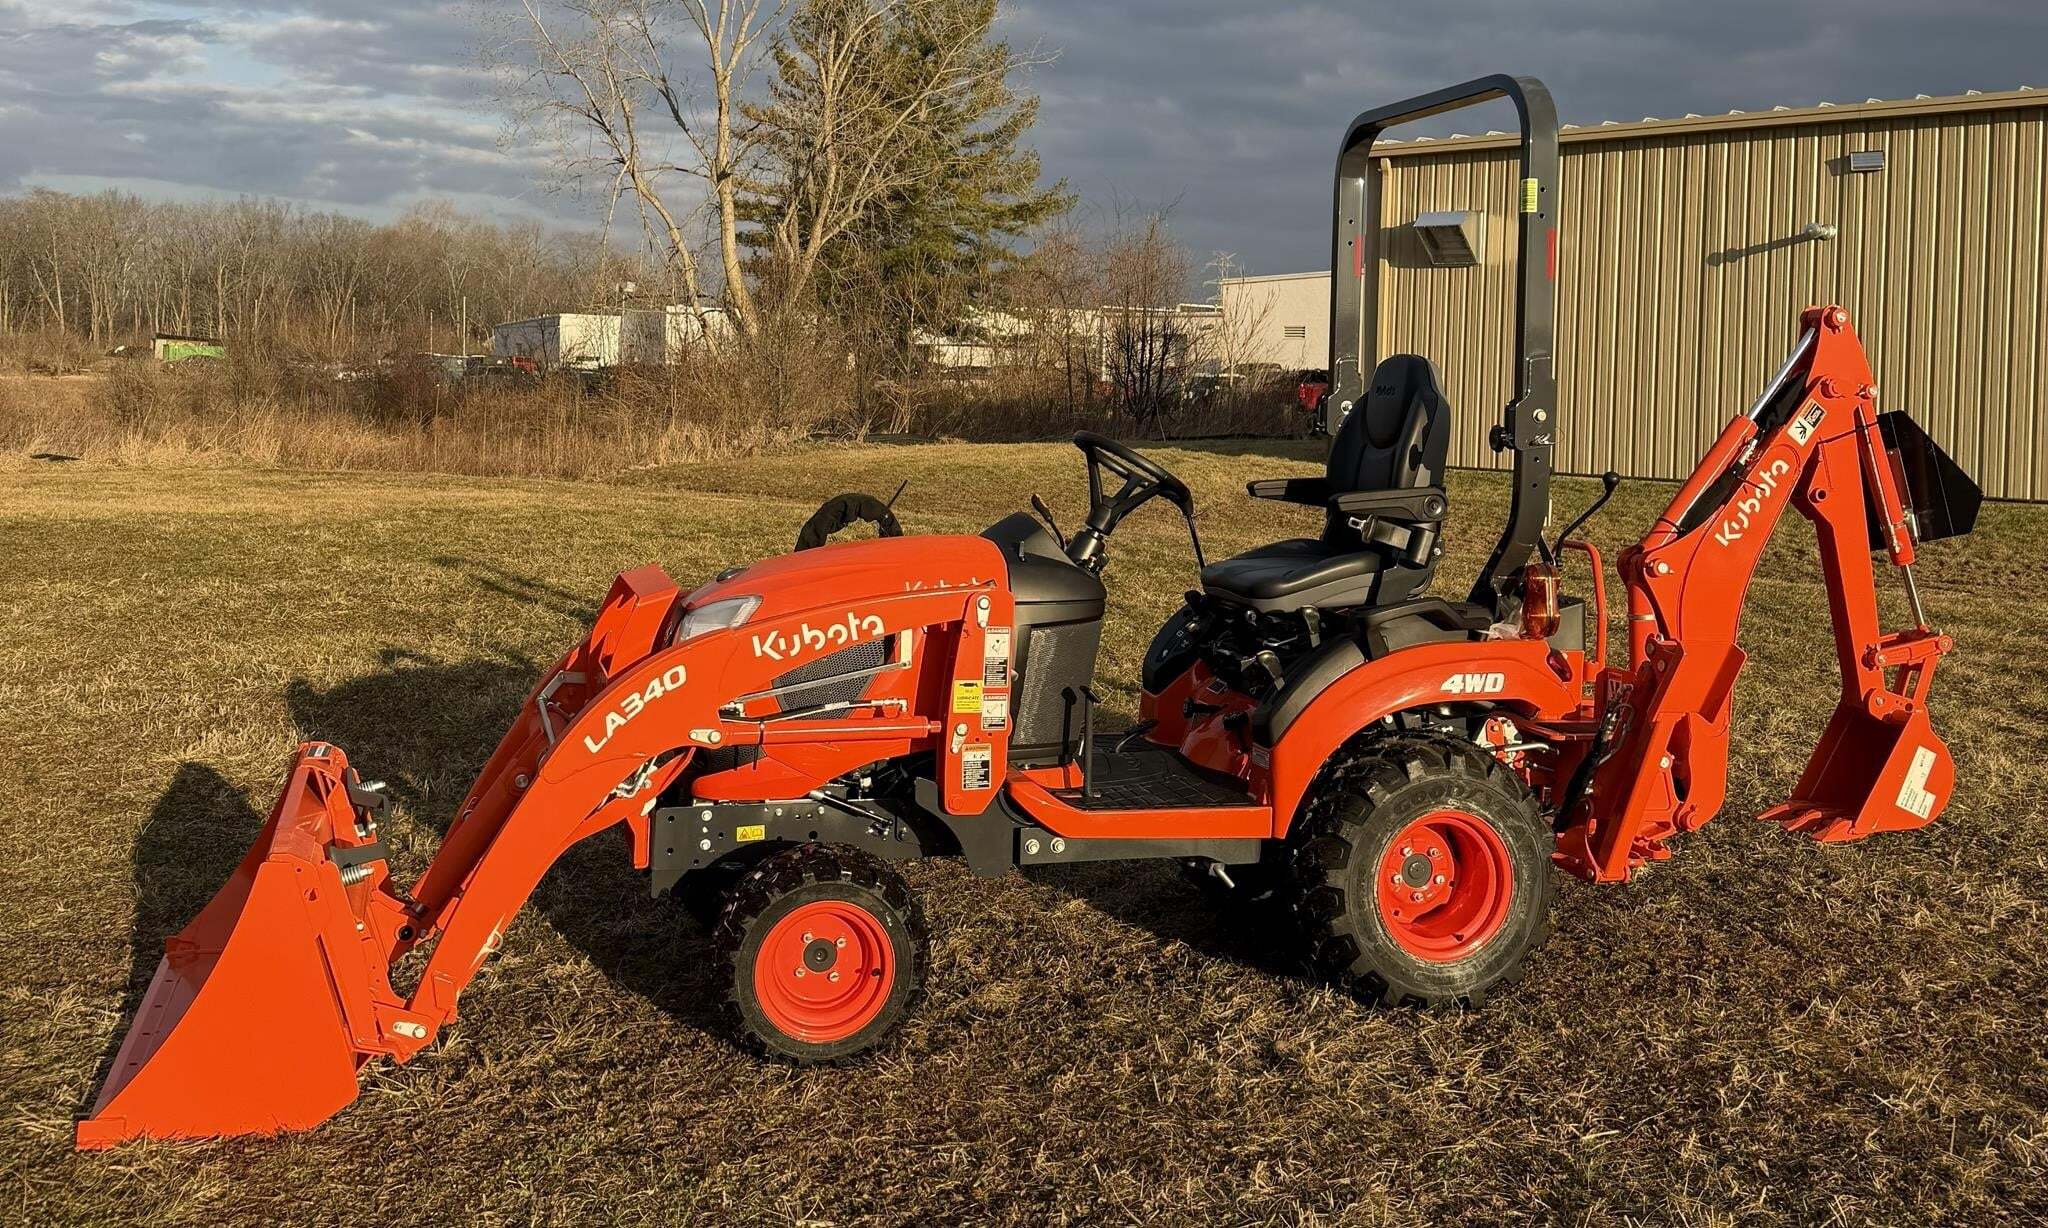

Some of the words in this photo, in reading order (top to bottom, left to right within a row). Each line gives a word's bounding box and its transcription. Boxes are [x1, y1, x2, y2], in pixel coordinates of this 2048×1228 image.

[1714, 459, 1790, 547] Kubota
[752, 611, 885, 661] Kubota
[583, 664, 687, 754] LA340
[1440, 672, 1505, 694] 4WD
